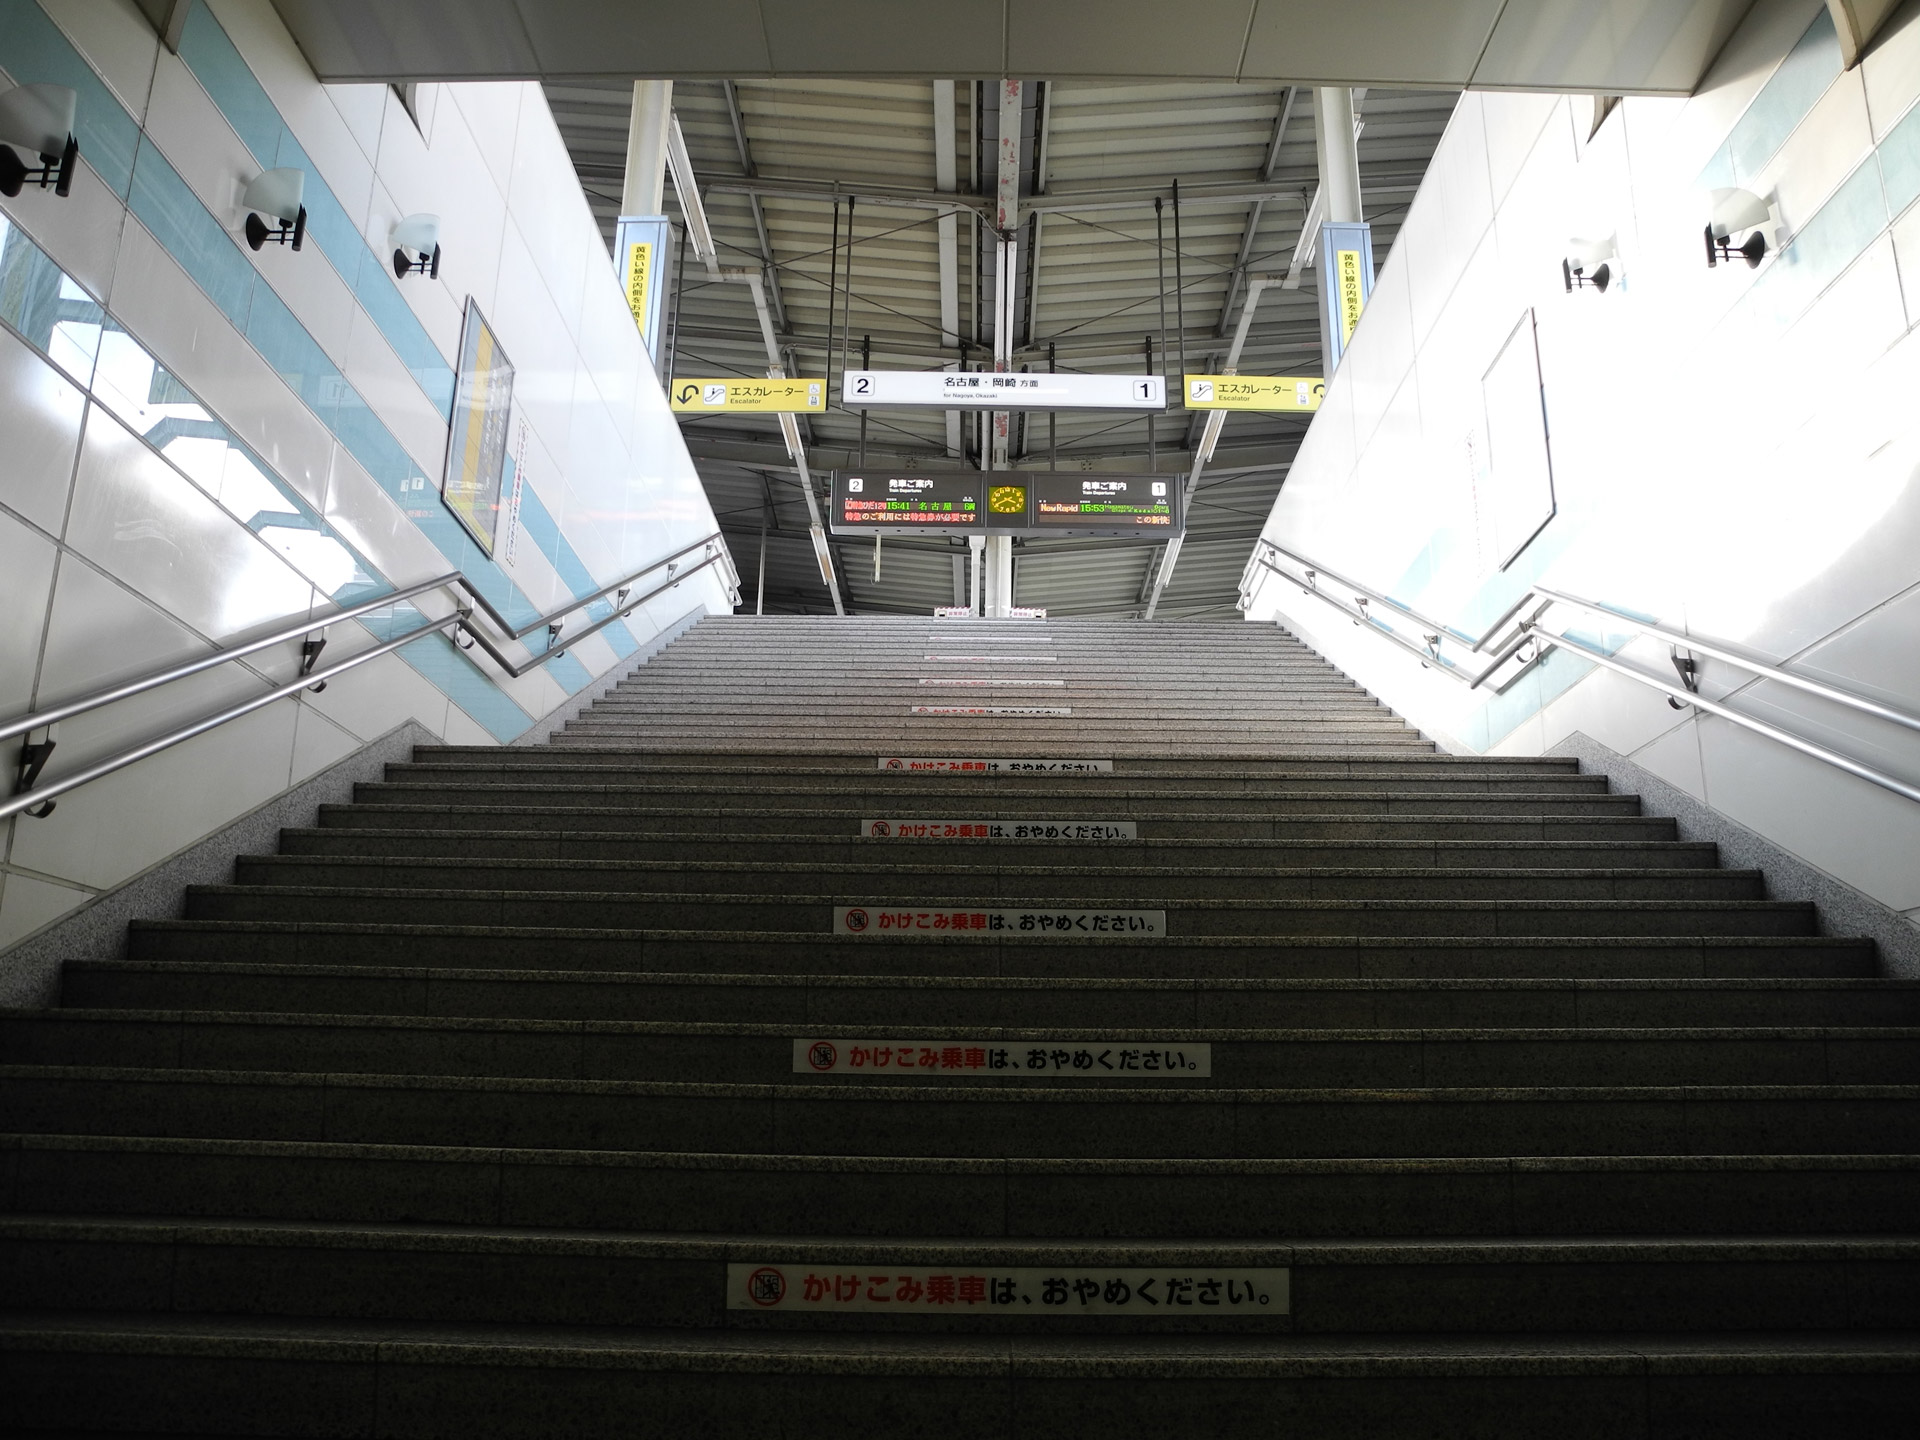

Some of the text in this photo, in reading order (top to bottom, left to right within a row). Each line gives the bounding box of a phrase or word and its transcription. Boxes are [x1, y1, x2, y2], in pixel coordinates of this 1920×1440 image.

[856, 378, 869, 393] 2
[944, 377, 1016, 387] 名古屋・岡崎
[730, 387, 804, 396] エスカレーター
[1140, 383, 1149, 398] 1
[1218, 384, 1292, 394] エスカレーター
[852, 480, 860, 490] 2
[889, 479, 934, 489] 発車ご案内
[1082, 481, 1127, 491] 発車ご案内
[1156, 484, 1161, 494] 1
[887, 502, 910, 510] 15:41
[918, 502, 952, 511] 名古屋
[1080, 504, 1105, 513] 15:53
[898, 824, 1127, 839] かけこみ乗車は、おやめください。
[878, 912, 1155, 932] かけこみ乗車は、おやめください。
[849, 1045, 1197, 1071] かけこみ乗車は、おやめください。
[803, 1273, 1270, 1306] かけこみ乗車は、おやめください。
